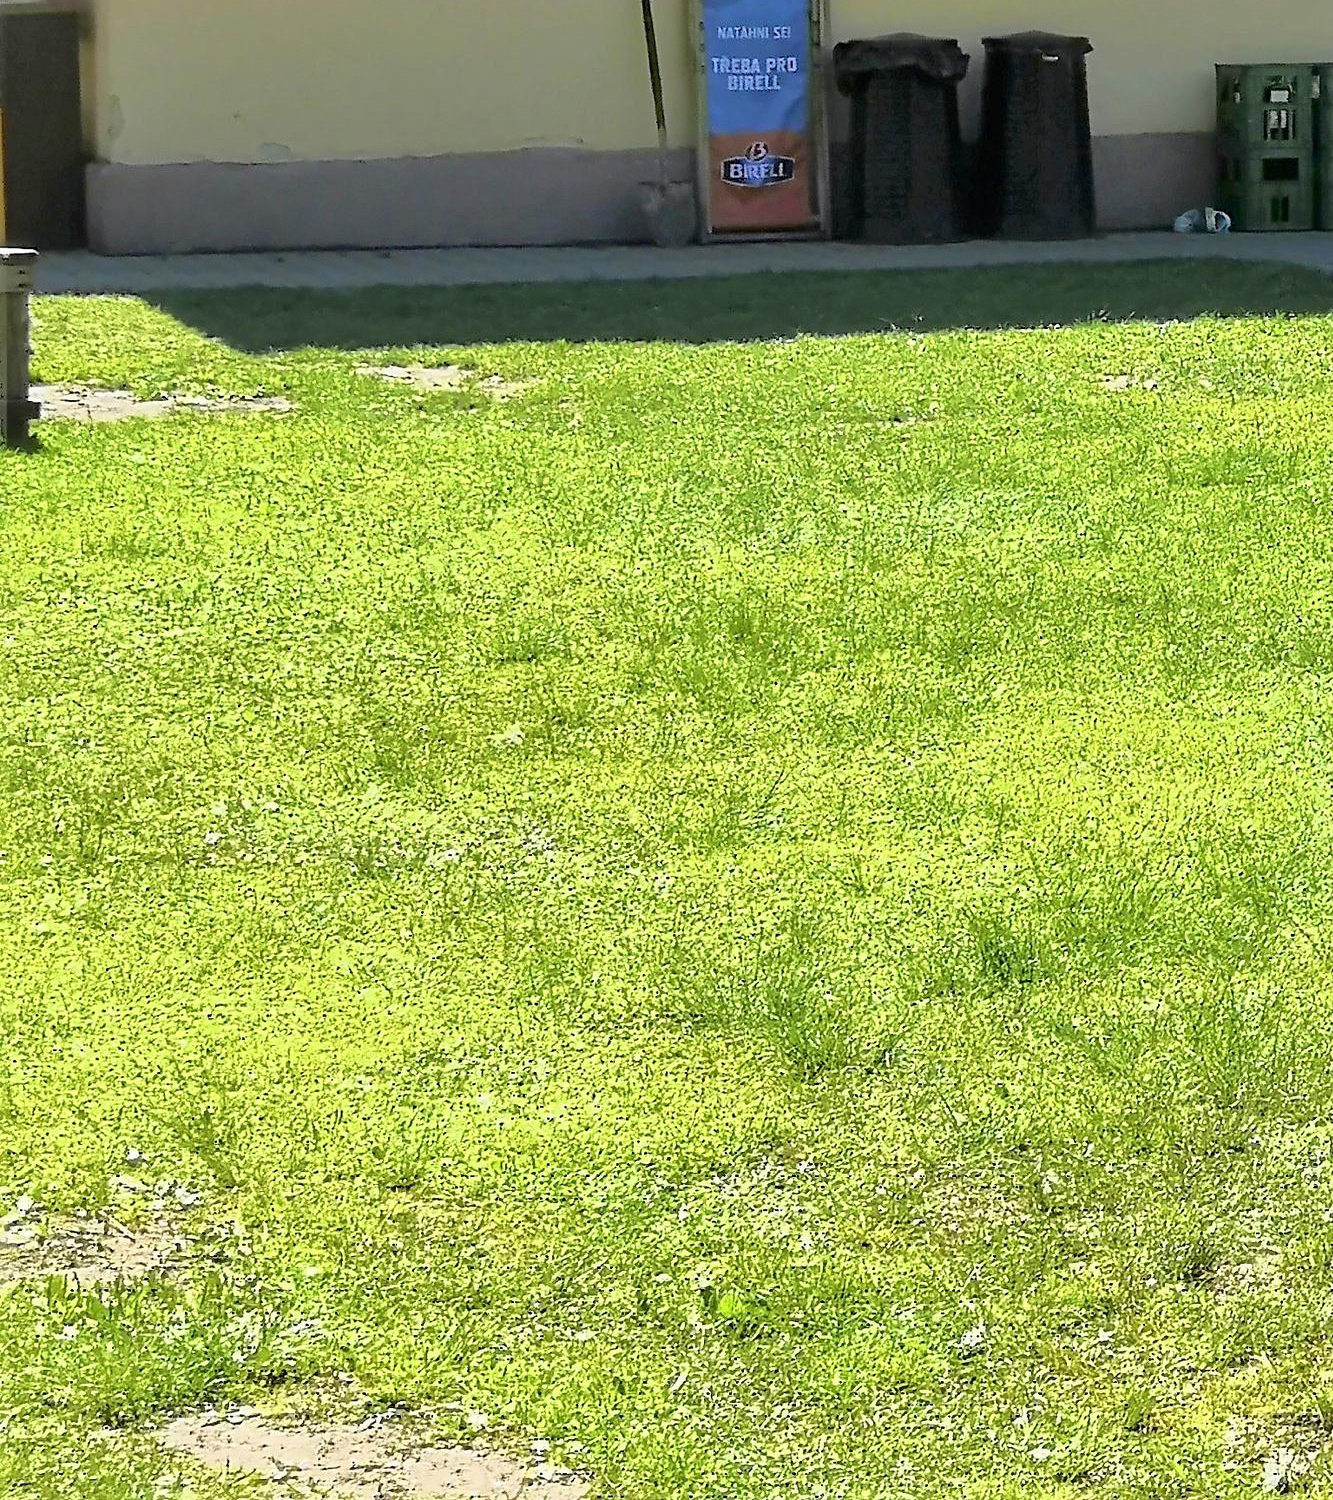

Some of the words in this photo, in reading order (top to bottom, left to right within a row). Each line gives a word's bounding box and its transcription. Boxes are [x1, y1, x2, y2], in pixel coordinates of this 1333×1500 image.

[711, 55, 761, 74] TŘEBA
[765, 56, 798, 73] PRO
[727, 74, 781, 91] BIRELL
[729, 161, 788, 180] BIRELL
